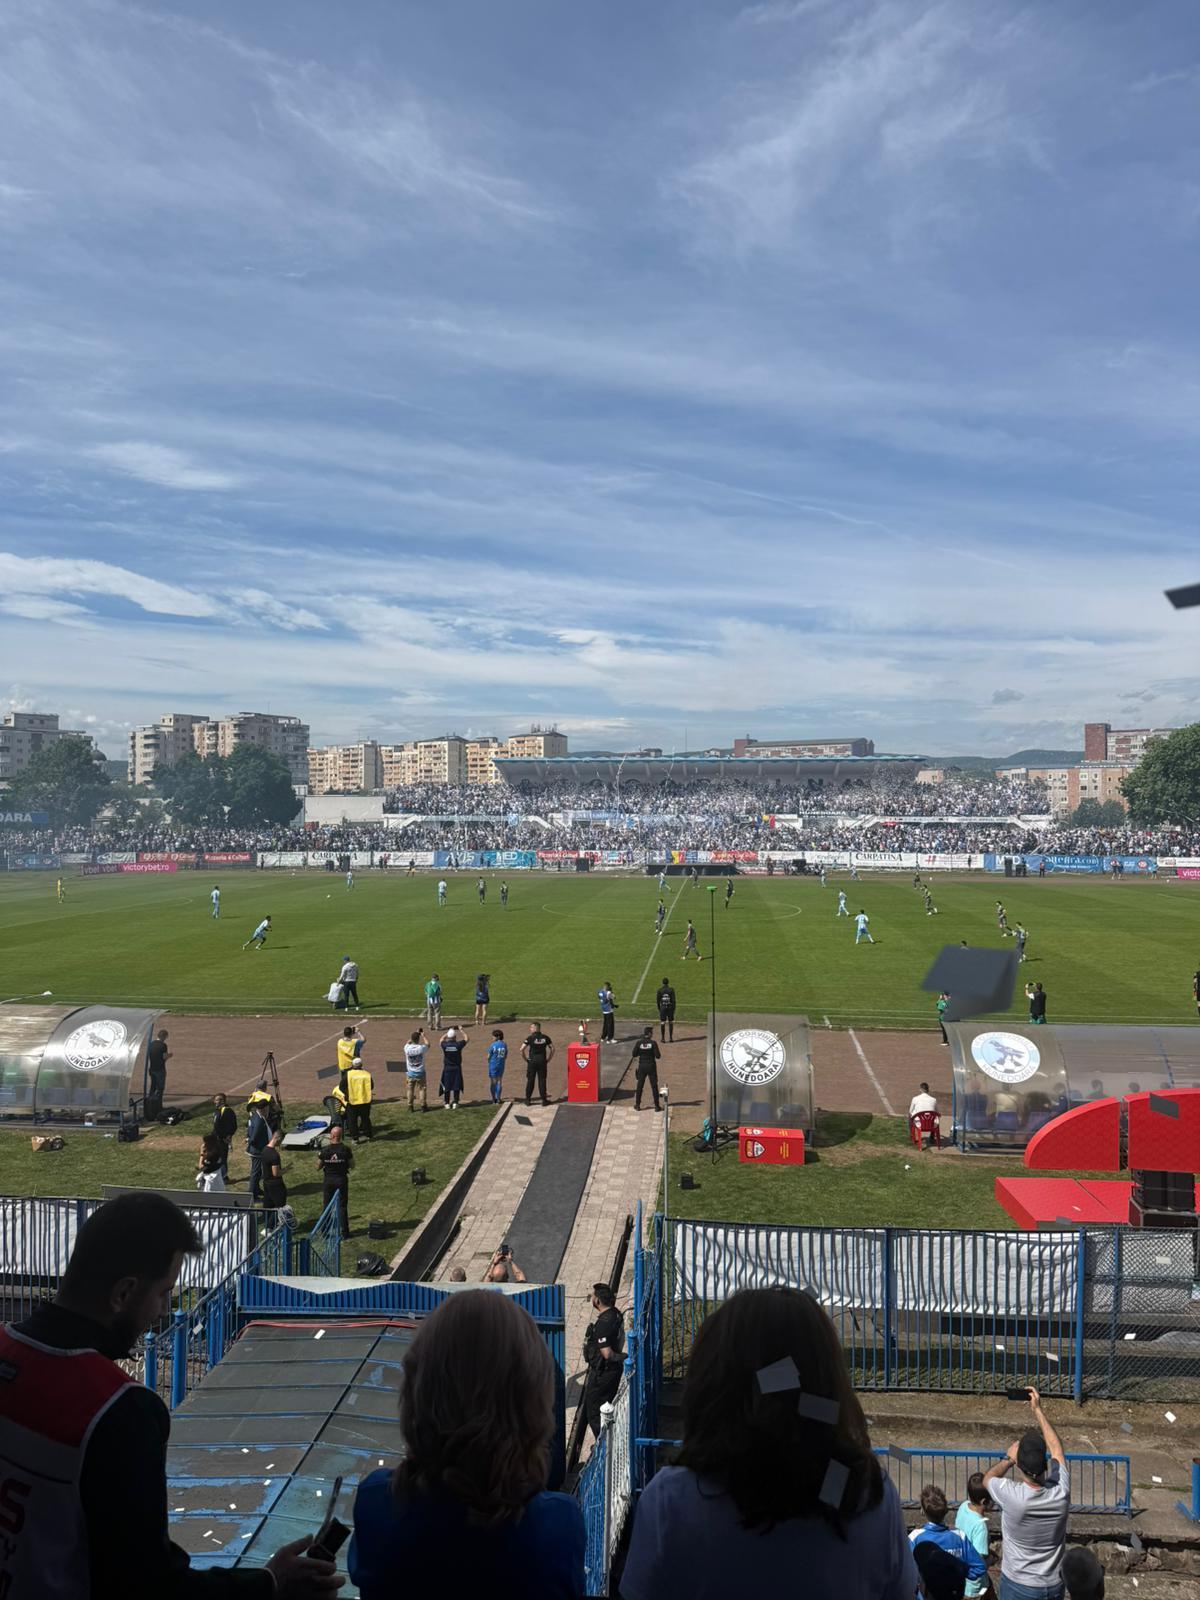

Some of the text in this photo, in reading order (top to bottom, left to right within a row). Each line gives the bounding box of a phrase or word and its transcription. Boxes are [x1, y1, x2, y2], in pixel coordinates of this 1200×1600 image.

[856, 852, 903, 861] CARPATINA
[996, 855, 1021, 865] MD
[123, 863, 169, 872] victorybet.ro
[728, 1062, 779, 1082] HUNEDOARA
[982, 1064, 1036, 1082] HUNEDOARA
